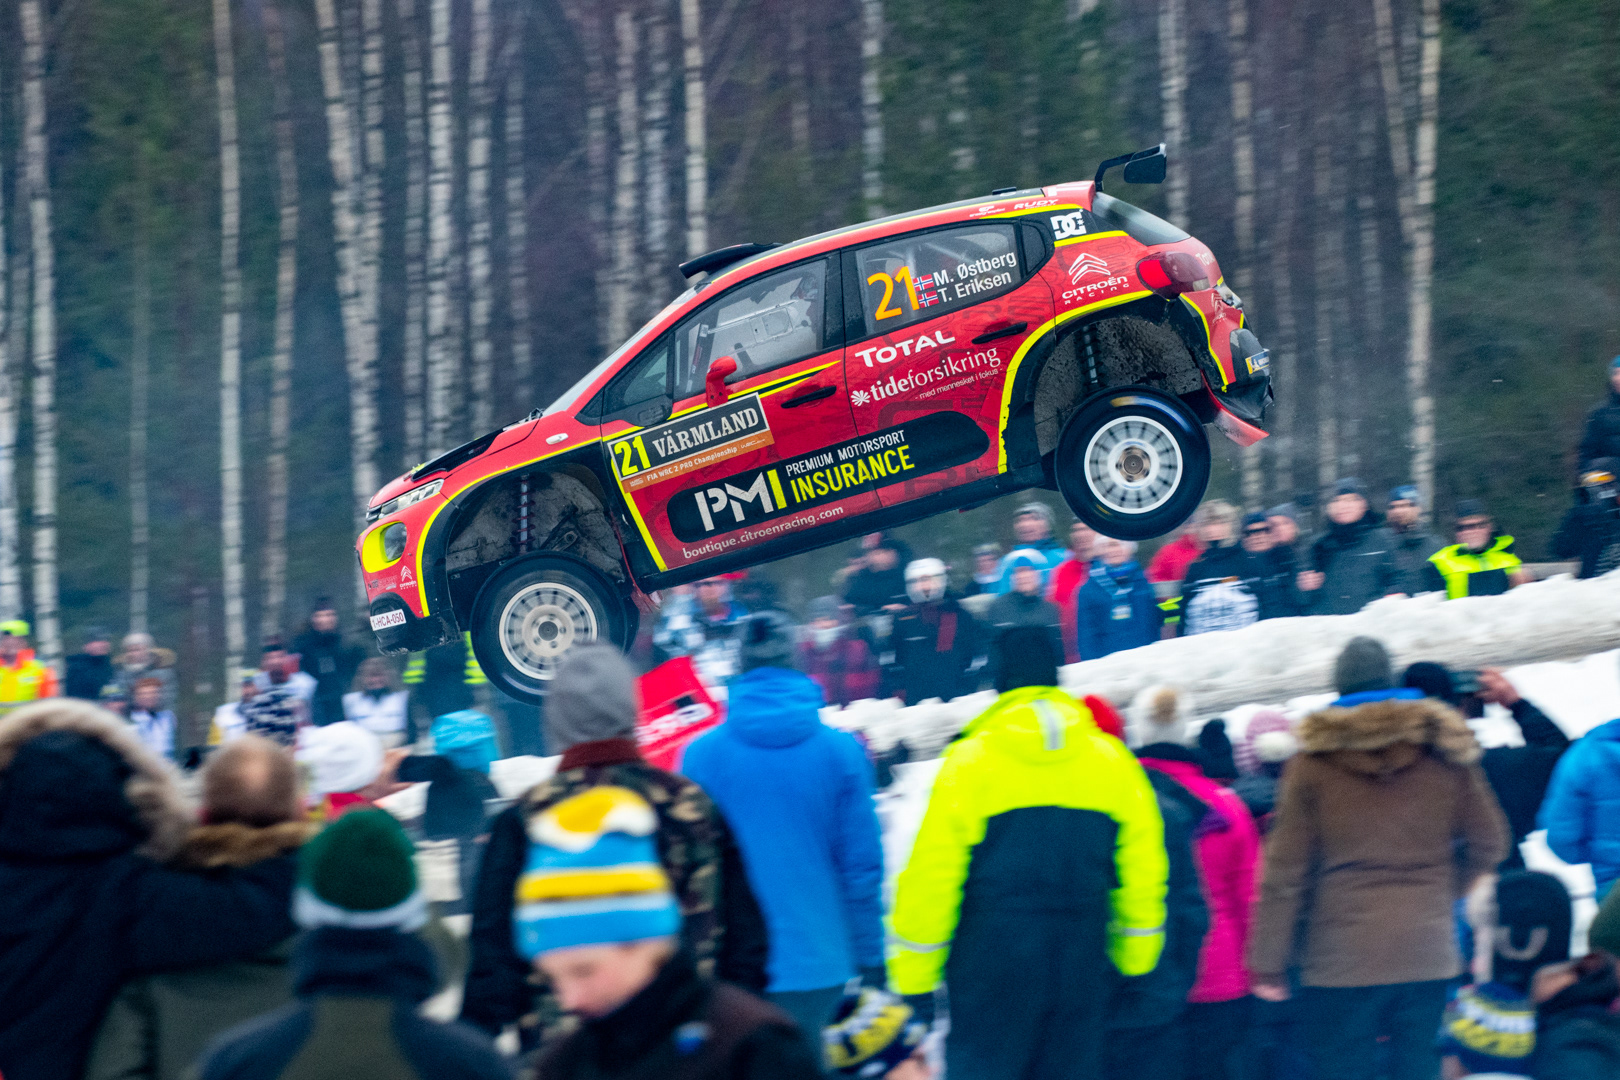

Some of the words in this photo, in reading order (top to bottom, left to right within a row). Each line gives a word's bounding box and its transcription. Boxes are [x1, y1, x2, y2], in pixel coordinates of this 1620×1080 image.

[1014, 199, 1059, 210] RUDY
[1050, 211, 1087, 240] DC
[933, 269, 954, 287] M.
[957, 252, 1017, 280] Østberg
[937, 288, 953, 303] T.
[955, 272, 1012, 298] Eriksen
[1062, 276, 1128, 299] CITROËN
[867, 266, 920, 321] 21
[855, 330, 956, 368] TOTAL
[870, 347, 1001, 401] tideforsikring
[919, 388, 935, 400] med
[937, 376, 975, 394] mennesket
[978, 369, 999, 380] fokus
[652, 407, 759, 458] VÄRMLAND
[614, 435, 651, 477] 21
[646, 472, 658, 482] FIA
[658, 467, 673, 479] WRC
[680, 461, 693, 471] PRO
[693, 446, 738, 465] Championship
[785, 452, 834, 477] PREMIUM
[837, 429, 906, 460] MOTORSPORT
[790, 444, 915, 504] INSURANCE
[694, 468, 788, 532] PMI
[683, 506, 844, 559] boutique.citroenracing.com
[371, 611, 405, 629] 1-HCA-050
